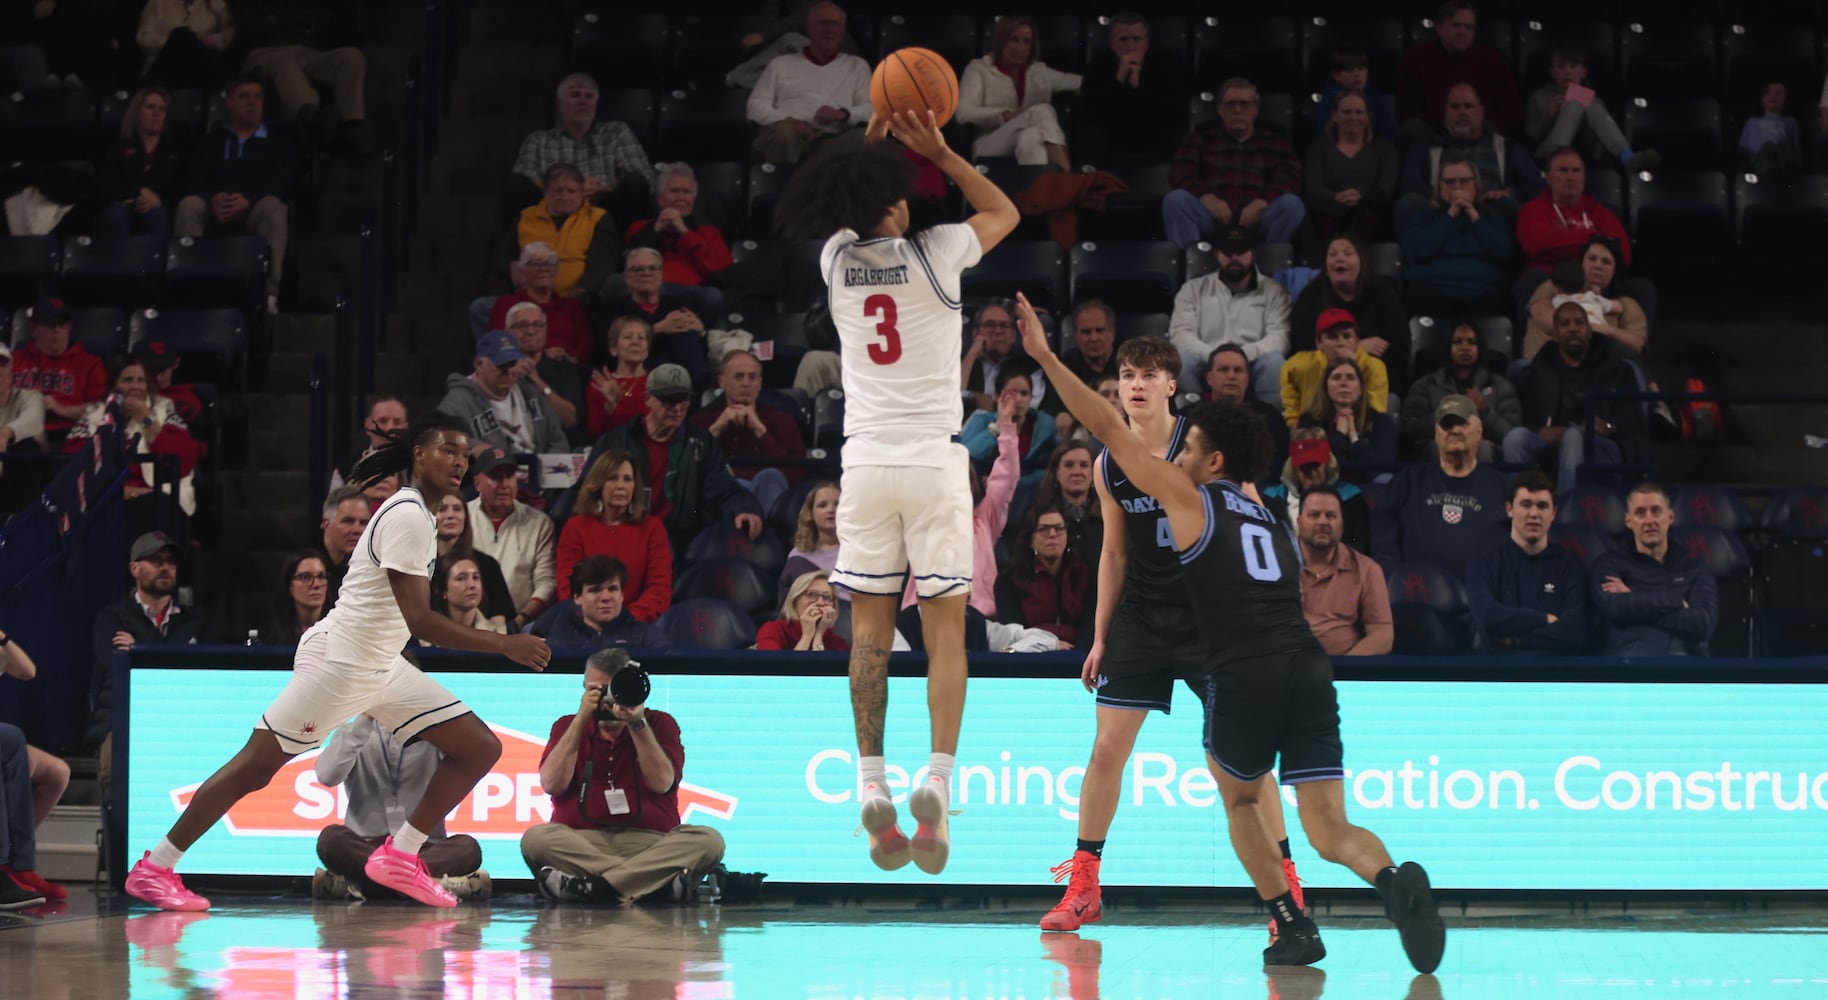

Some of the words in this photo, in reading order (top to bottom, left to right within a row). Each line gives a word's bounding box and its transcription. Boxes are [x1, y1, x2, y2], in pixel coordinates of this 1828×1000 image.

[844, 265, 909, 287] ARGABRIGHT
[863, 293, 902, 365] 3
[1156, 517, 1180, 552] 4
[1240, 522, 1283, 582] 0
